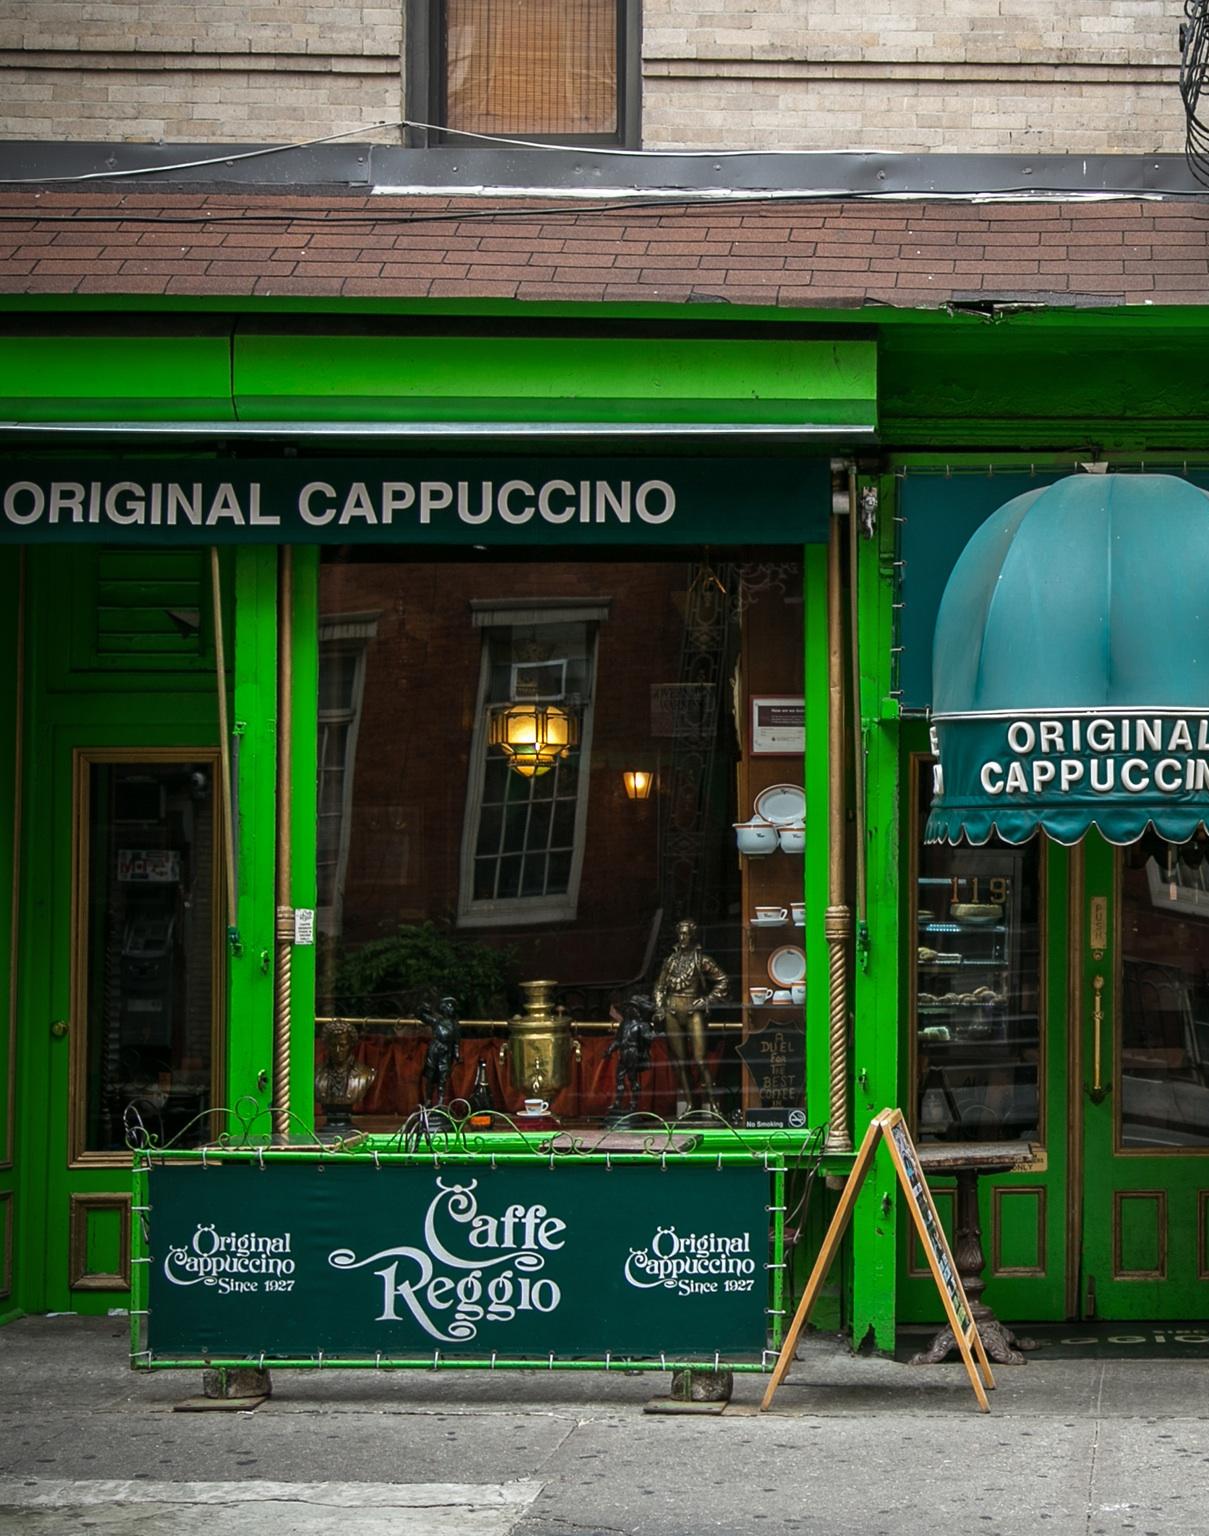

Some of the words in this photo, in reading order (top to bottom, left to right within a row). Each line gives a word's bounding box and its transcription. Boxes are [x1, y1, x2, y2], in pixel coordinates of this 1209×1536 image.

[4, 481, 281, 526] ORIGINAL
[298, 480, 677, 526] CAPPUCCINO
[950, 876, 1007, 904] 119
[760, 1041, 795, 1053] DUEL
[760, 1088, 796, 1099] COFFEE
[763, 1075, 796, 1089] BEST
[757, 1121, 784, 1129] Smoking
[424, 1176, 567, 1272] Caffe
[192, 1223, 292, 1257] Original
[652, 1225, 751, 1259] Original
[164, 1244, 296, 1286] Cappuccino
[624, 1247, 756, 1289] Cappuccino
[218, 1277, 259, 1295] Since
[264, 1279, 296, 1292] 1927
[328, 1246, 562, 1343] Reggio
[678, 1279, 719, 1297] Since
[724, 1279, 755, 1292] 1927
